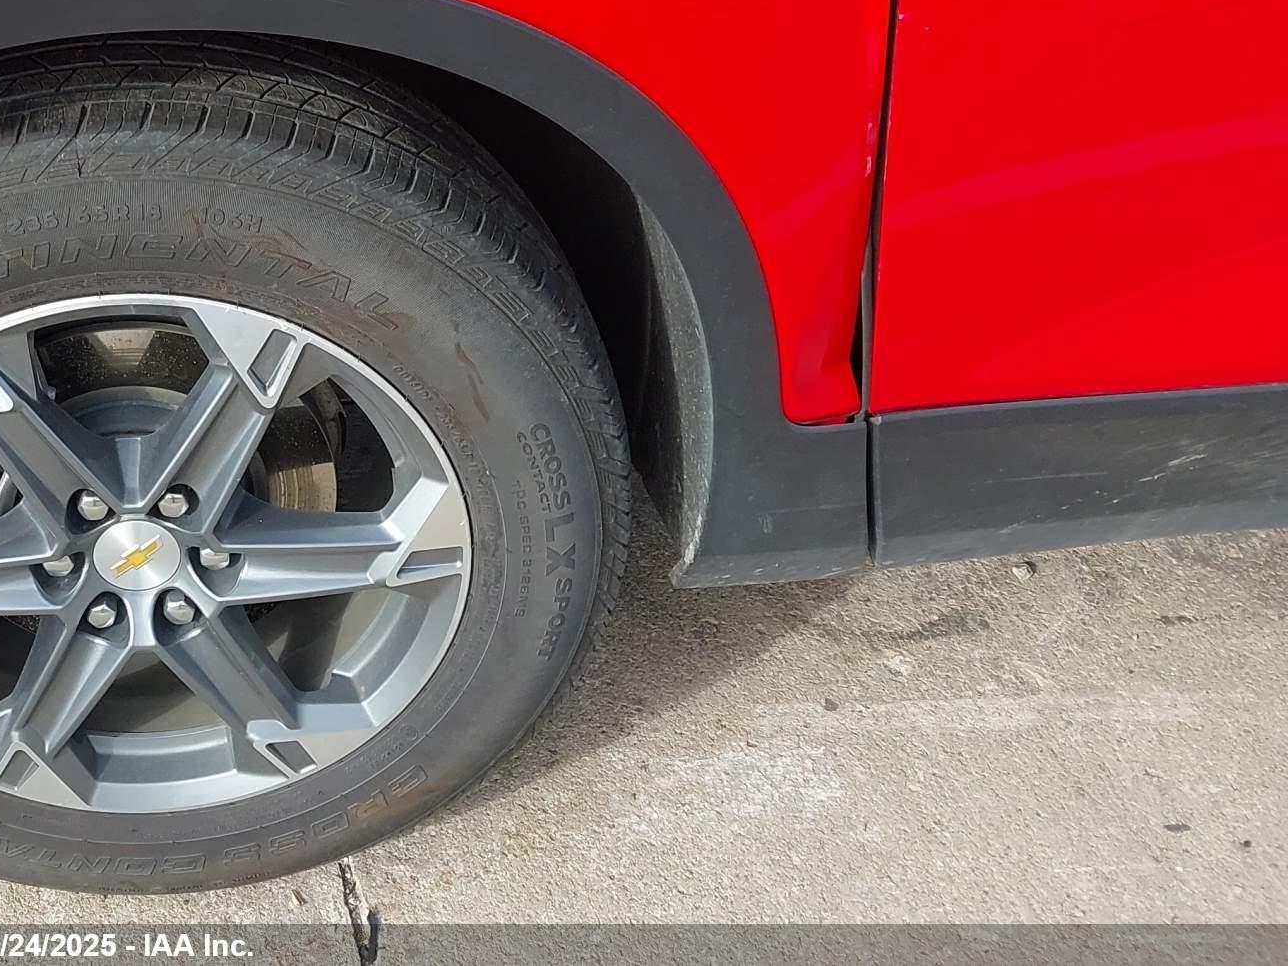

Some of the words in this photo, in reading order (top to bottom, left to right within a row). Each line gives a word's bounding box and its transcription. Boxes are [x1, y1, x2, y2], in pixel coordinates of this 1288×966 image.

[516, 431, 552, 513] CONTACT
[528, 422, 572, 511] CROSS
[518, 515, 532, 554] SPEC
[536, 577, 573, 661] SPORT
[223, 764, 429, 867] CROSS
